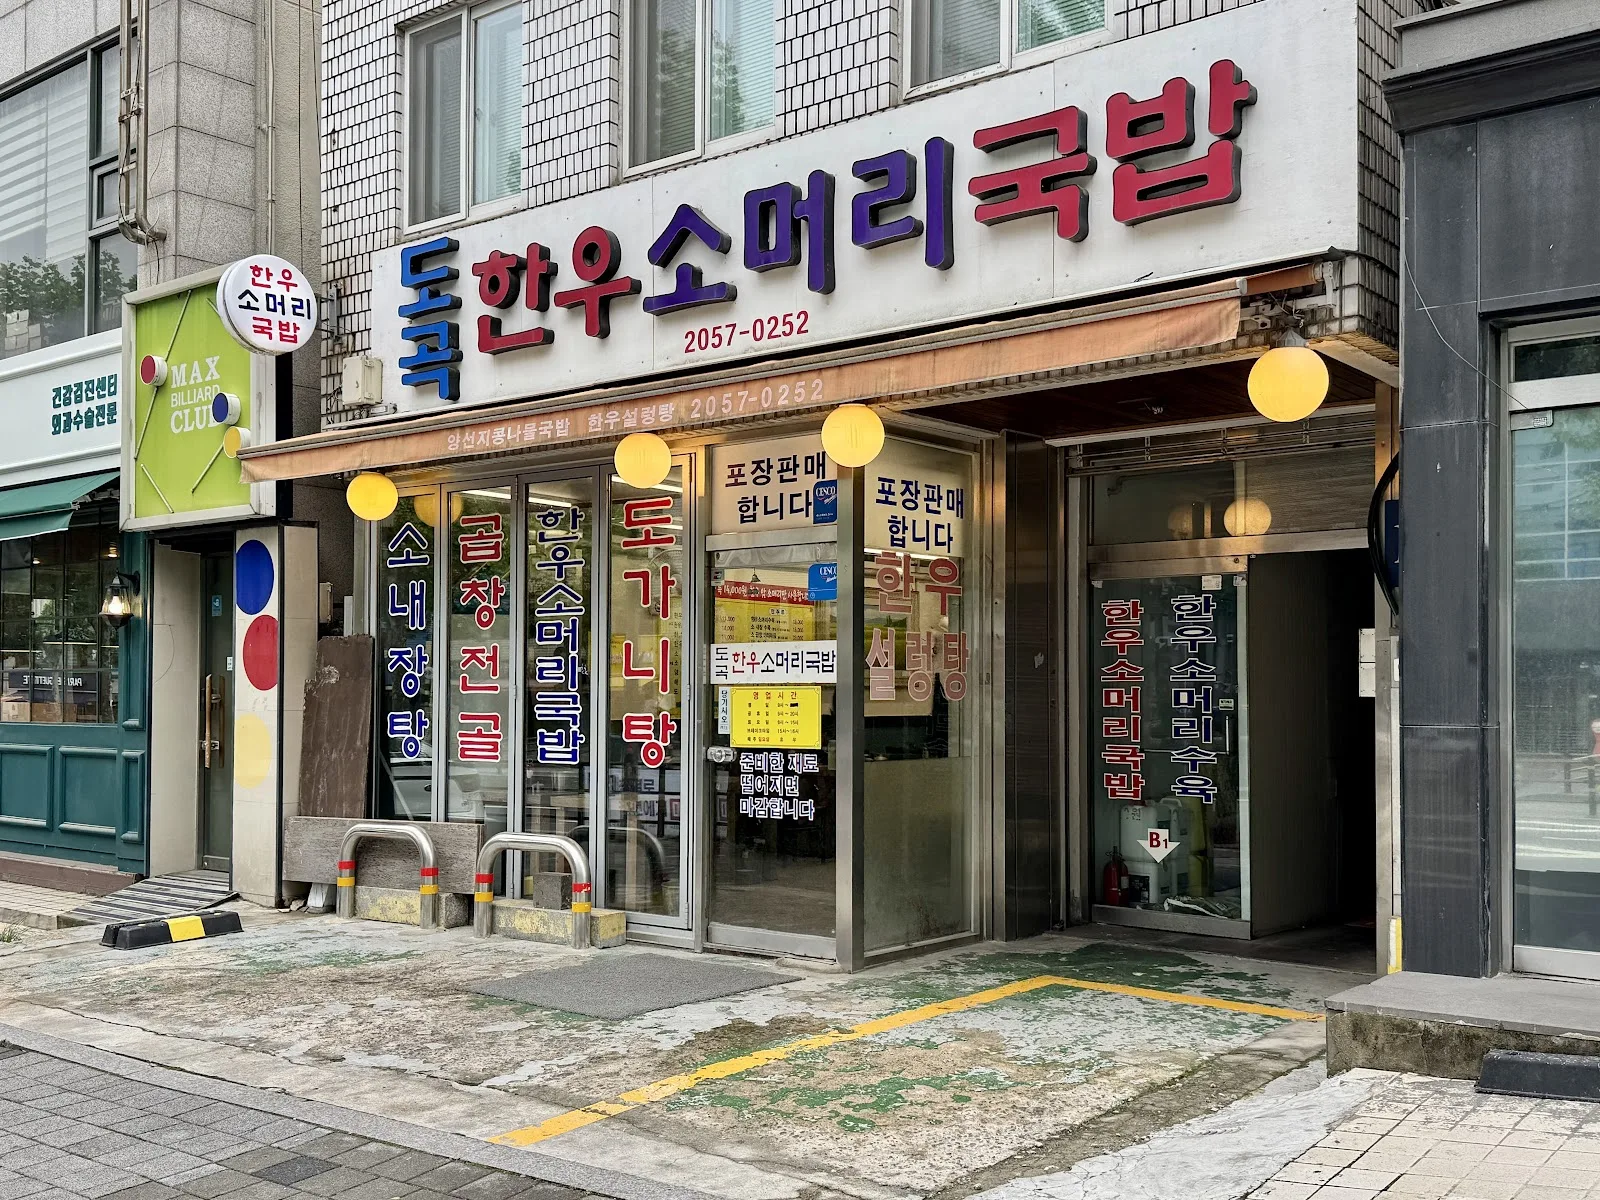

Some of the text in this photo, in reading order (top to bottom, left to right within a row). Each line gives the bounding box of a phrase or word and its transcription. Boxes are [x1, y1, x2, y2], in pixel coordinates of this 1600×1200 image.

[250, 264, 298, 292] 한우
[238, 289, 311, 320] 소머리
[399, 237, 461, 401] 도곡
[252, 316, 300, 344] 국밥
[684, 310, 809, 354] 2057-0252
[171, 355, 220, 389] MAX
[52, 374, 117, 408] 건강검진센터
[171, 384, 220, 408] BILLIARD
[588, 402, 675, 432] 한우설렁탕
[690, 378, 824, 419] 2057-0252
[51, 402, 117, 435] 외과수술전문
[725, 451, 826, 488] 포장판매
[737, 490, 812, 524] 합니다
[876, 477, 964, 519] 포장판매
[888, 515, 953, 553] 합니다
[875, 551, 963, 616] 한우
[387, 522, 429, 759] 소내장탕
[457, 513, 505, 762] 곱창전골
[534, 506, 585, 765] 한우소머리국밥
[621, 496, 677, 768] 도가니탕
[715, 647, 836, 680] 도곡 한우소머리국밥
[865, 627, 970, 701] 설렁탕
[1101, 600, 1145, 800] 한우소머리국밥
[1170, 594, 1217, 804] 한우소머리수육
[740, 752, 819, 774] 준비한 재료
[741, 774, 799, 797] 떨어지면
[740, 797, 815, 821] 마감합니다
[1149, 831, 1168, 849] B1
